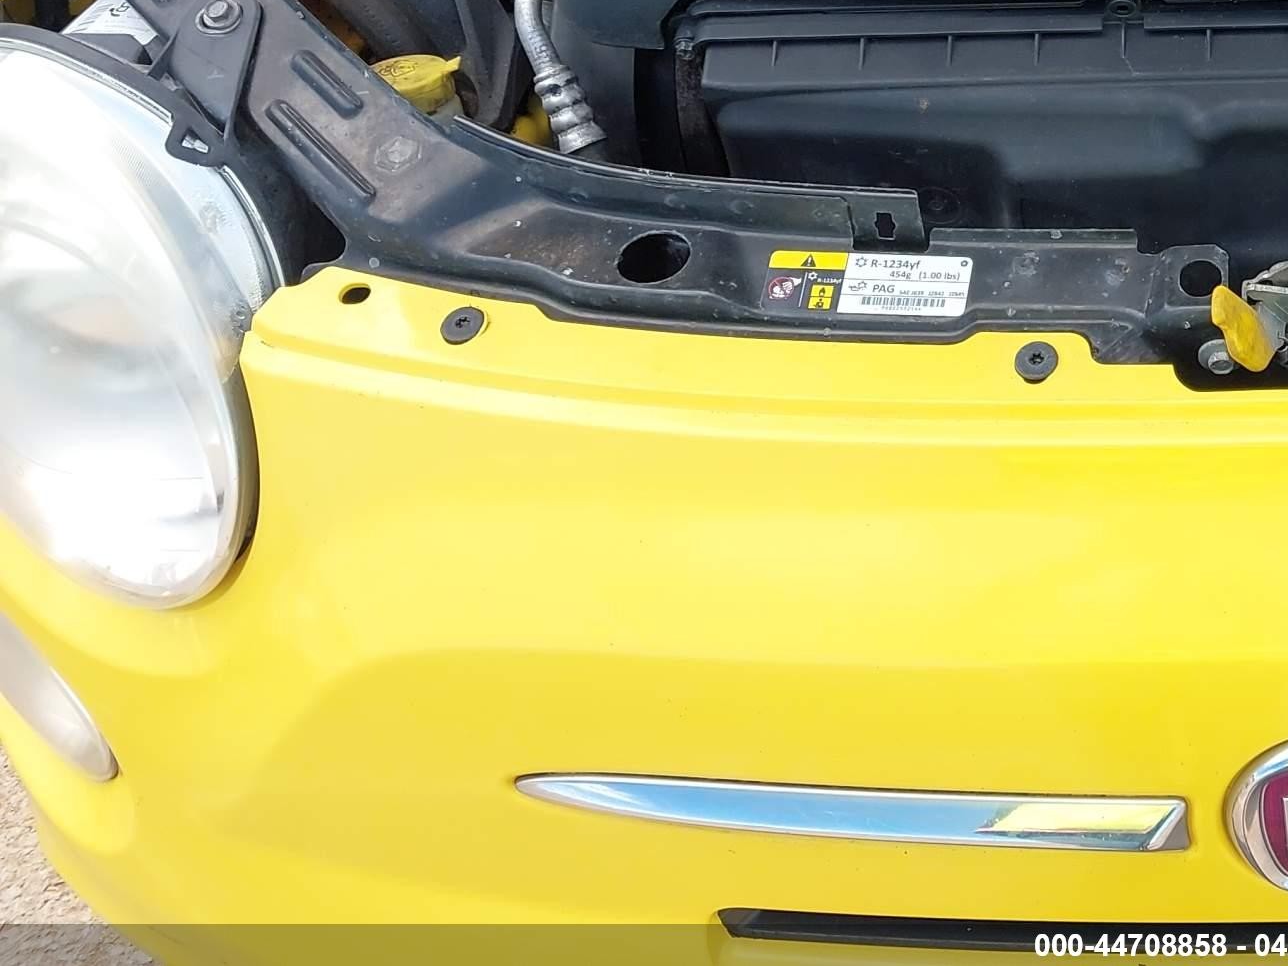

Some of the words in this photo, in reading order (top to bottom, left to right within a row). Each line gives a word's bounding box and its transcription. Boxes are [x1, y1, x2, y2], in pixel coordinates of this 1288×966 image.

[871, 260, 920, 270] R-1234yf
[890, 271, 911, 280] 454g
[919, 272, 942, 280] (1.00
[944, 272, 960, 280] lbs)
[872, 284, 895, 293] PAG
